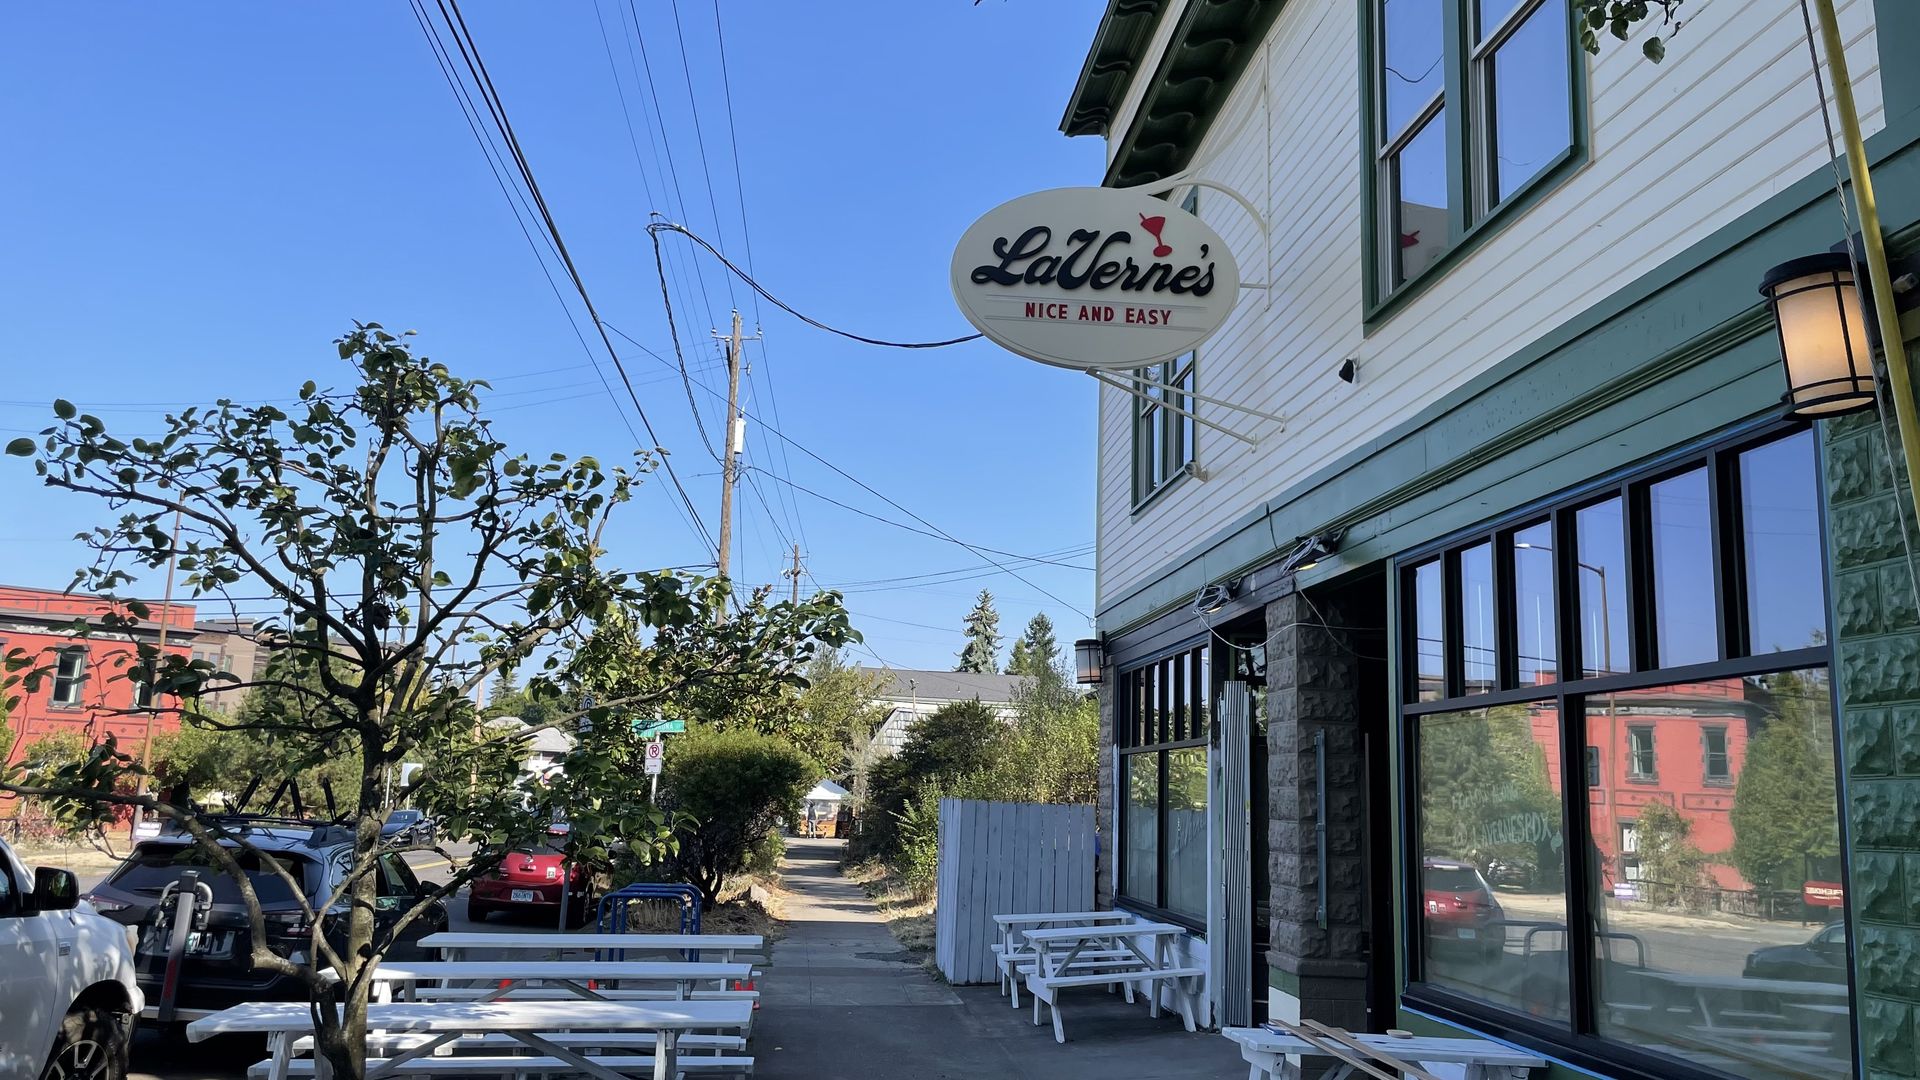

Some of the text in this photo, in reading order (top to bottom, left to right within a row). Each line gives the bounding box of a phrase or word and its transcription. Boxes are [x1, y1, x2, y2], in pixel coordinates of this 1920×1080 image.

[970, 225, 1216, 297] LaVerne's
[1025, 302, 1172, 326] NICE AND EASY
